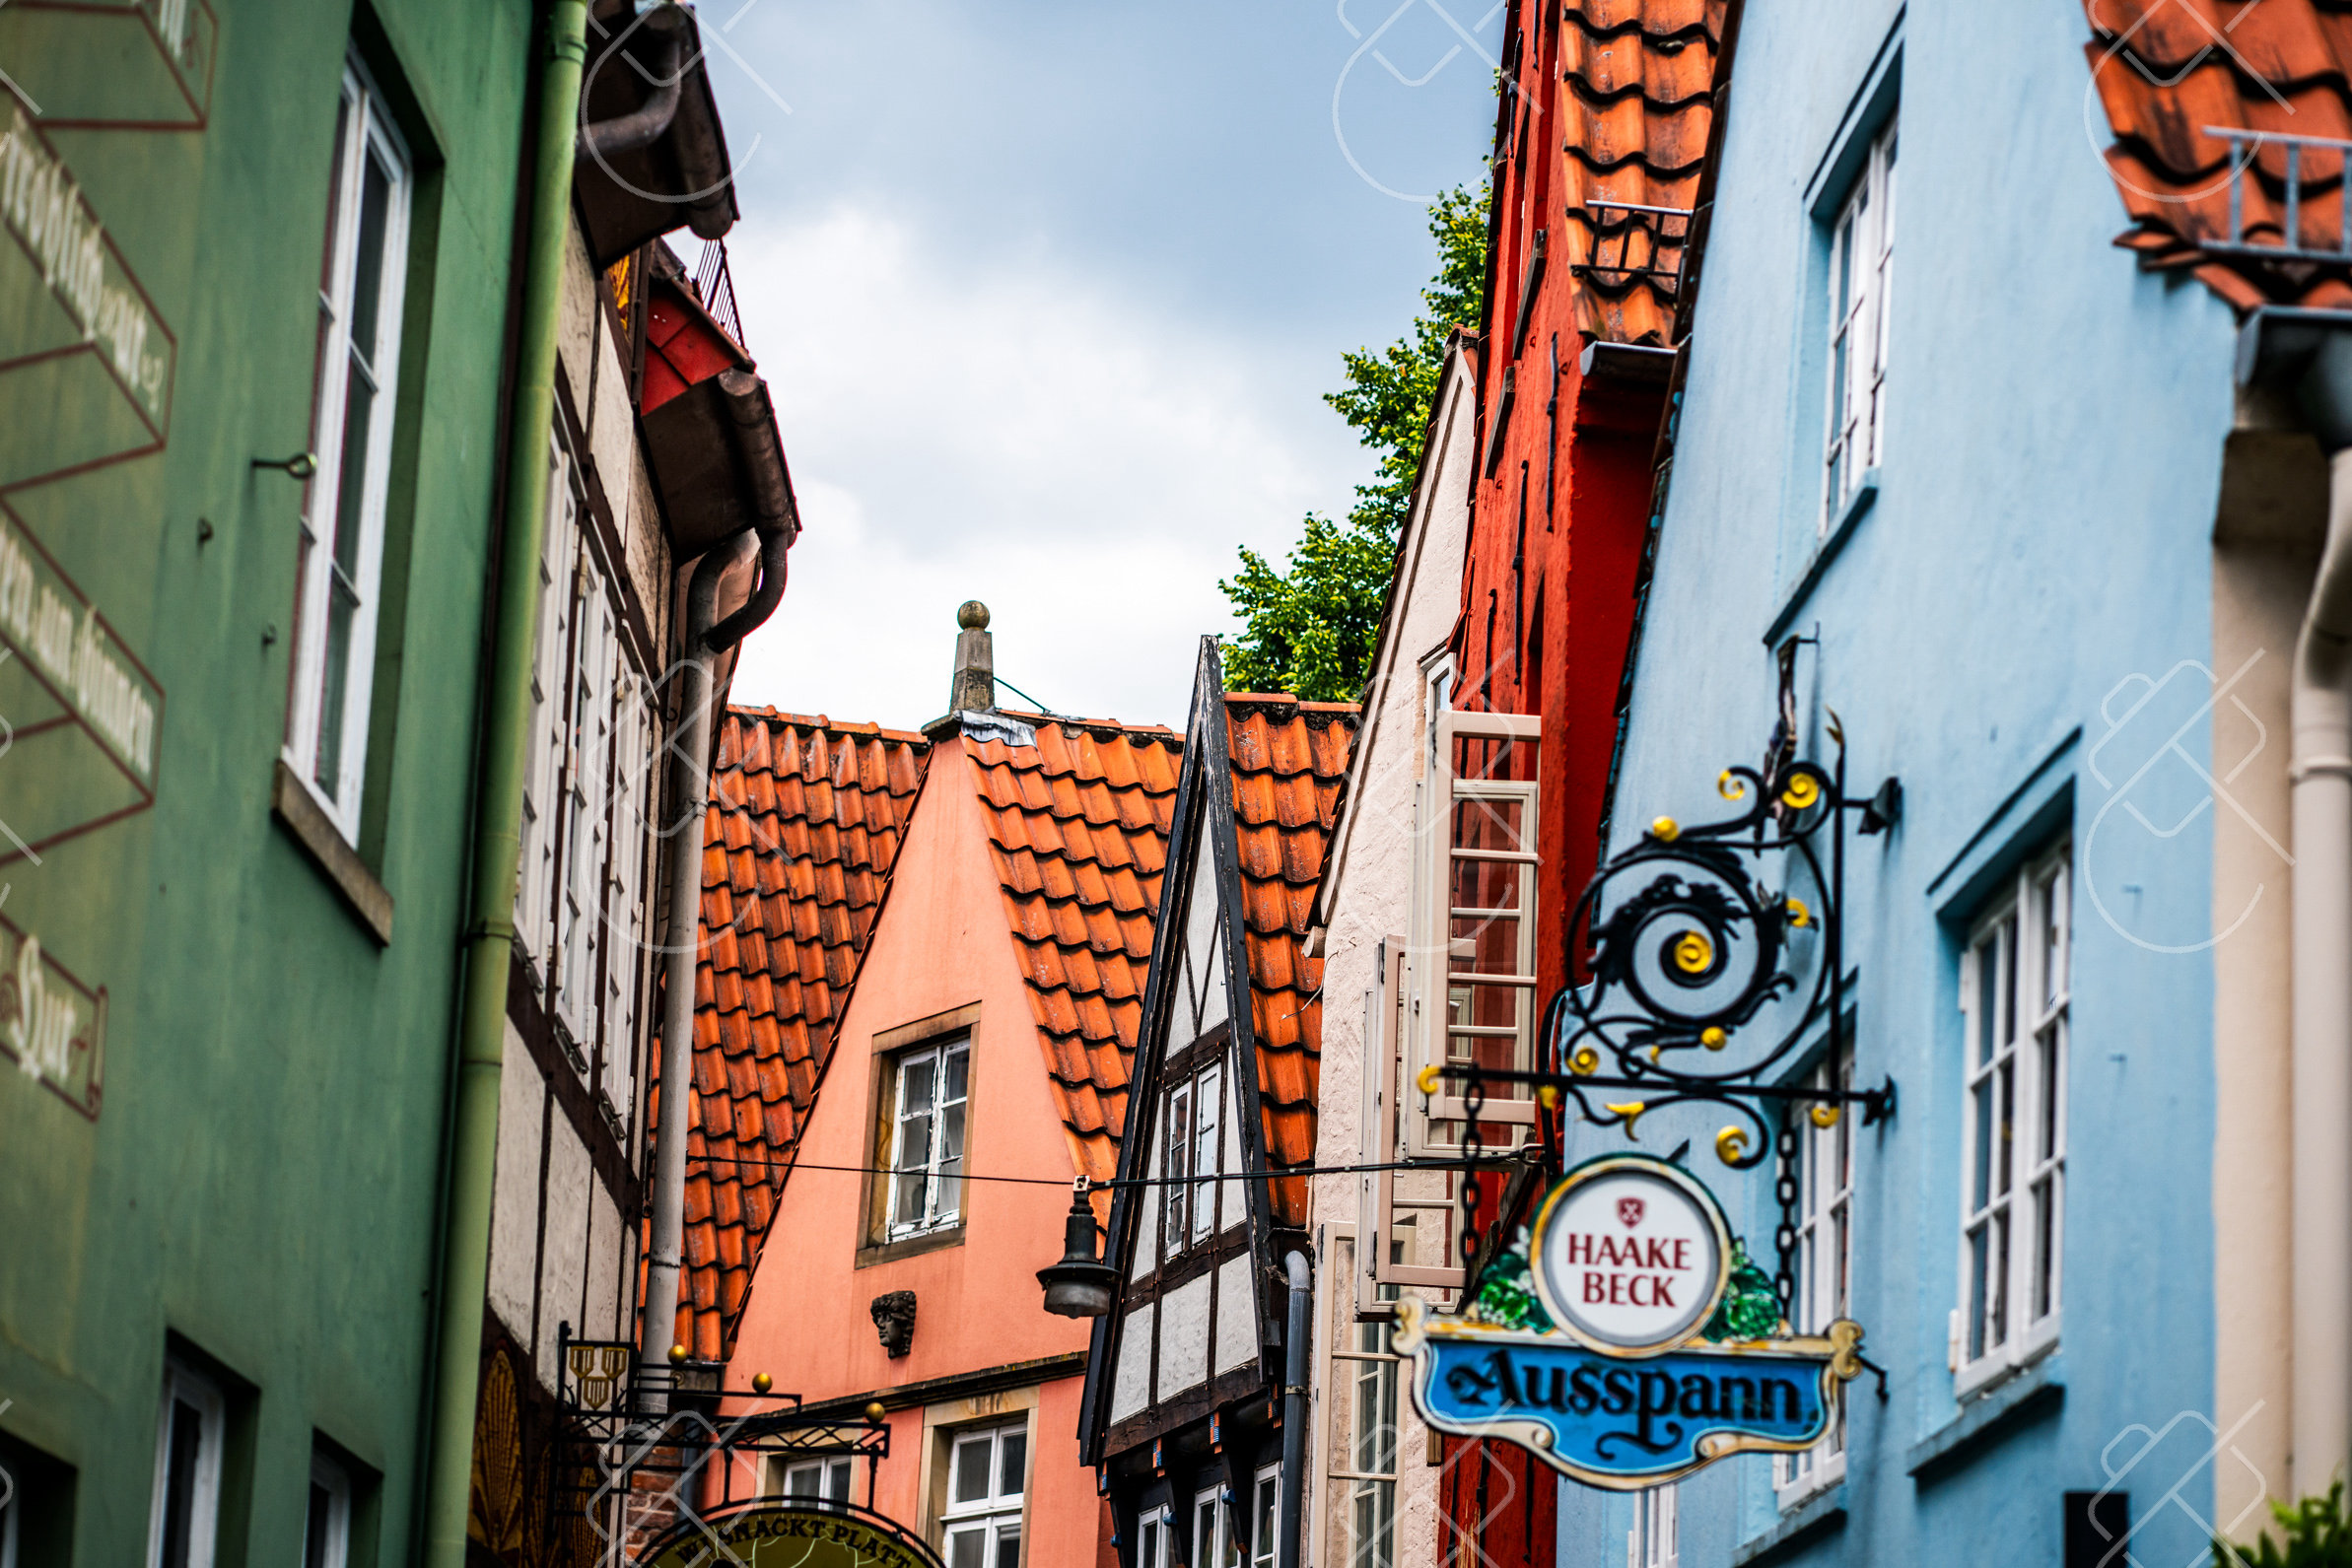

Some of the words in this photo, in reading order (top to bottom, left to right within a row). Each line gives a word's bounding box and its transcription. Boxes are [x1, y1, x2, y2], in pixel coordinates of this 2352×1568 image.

[1567, 1233, 1693, 1272] HAAKE
[1582, 1272, 1678, 1308] BECK
[1446, 1349, 1802, 1460] Ausspann
[675, 1535, 712, 1565] WI
[720, 1518, 827, 1546] SNACKT
[833, 1524, 911, 1568] PLATT
